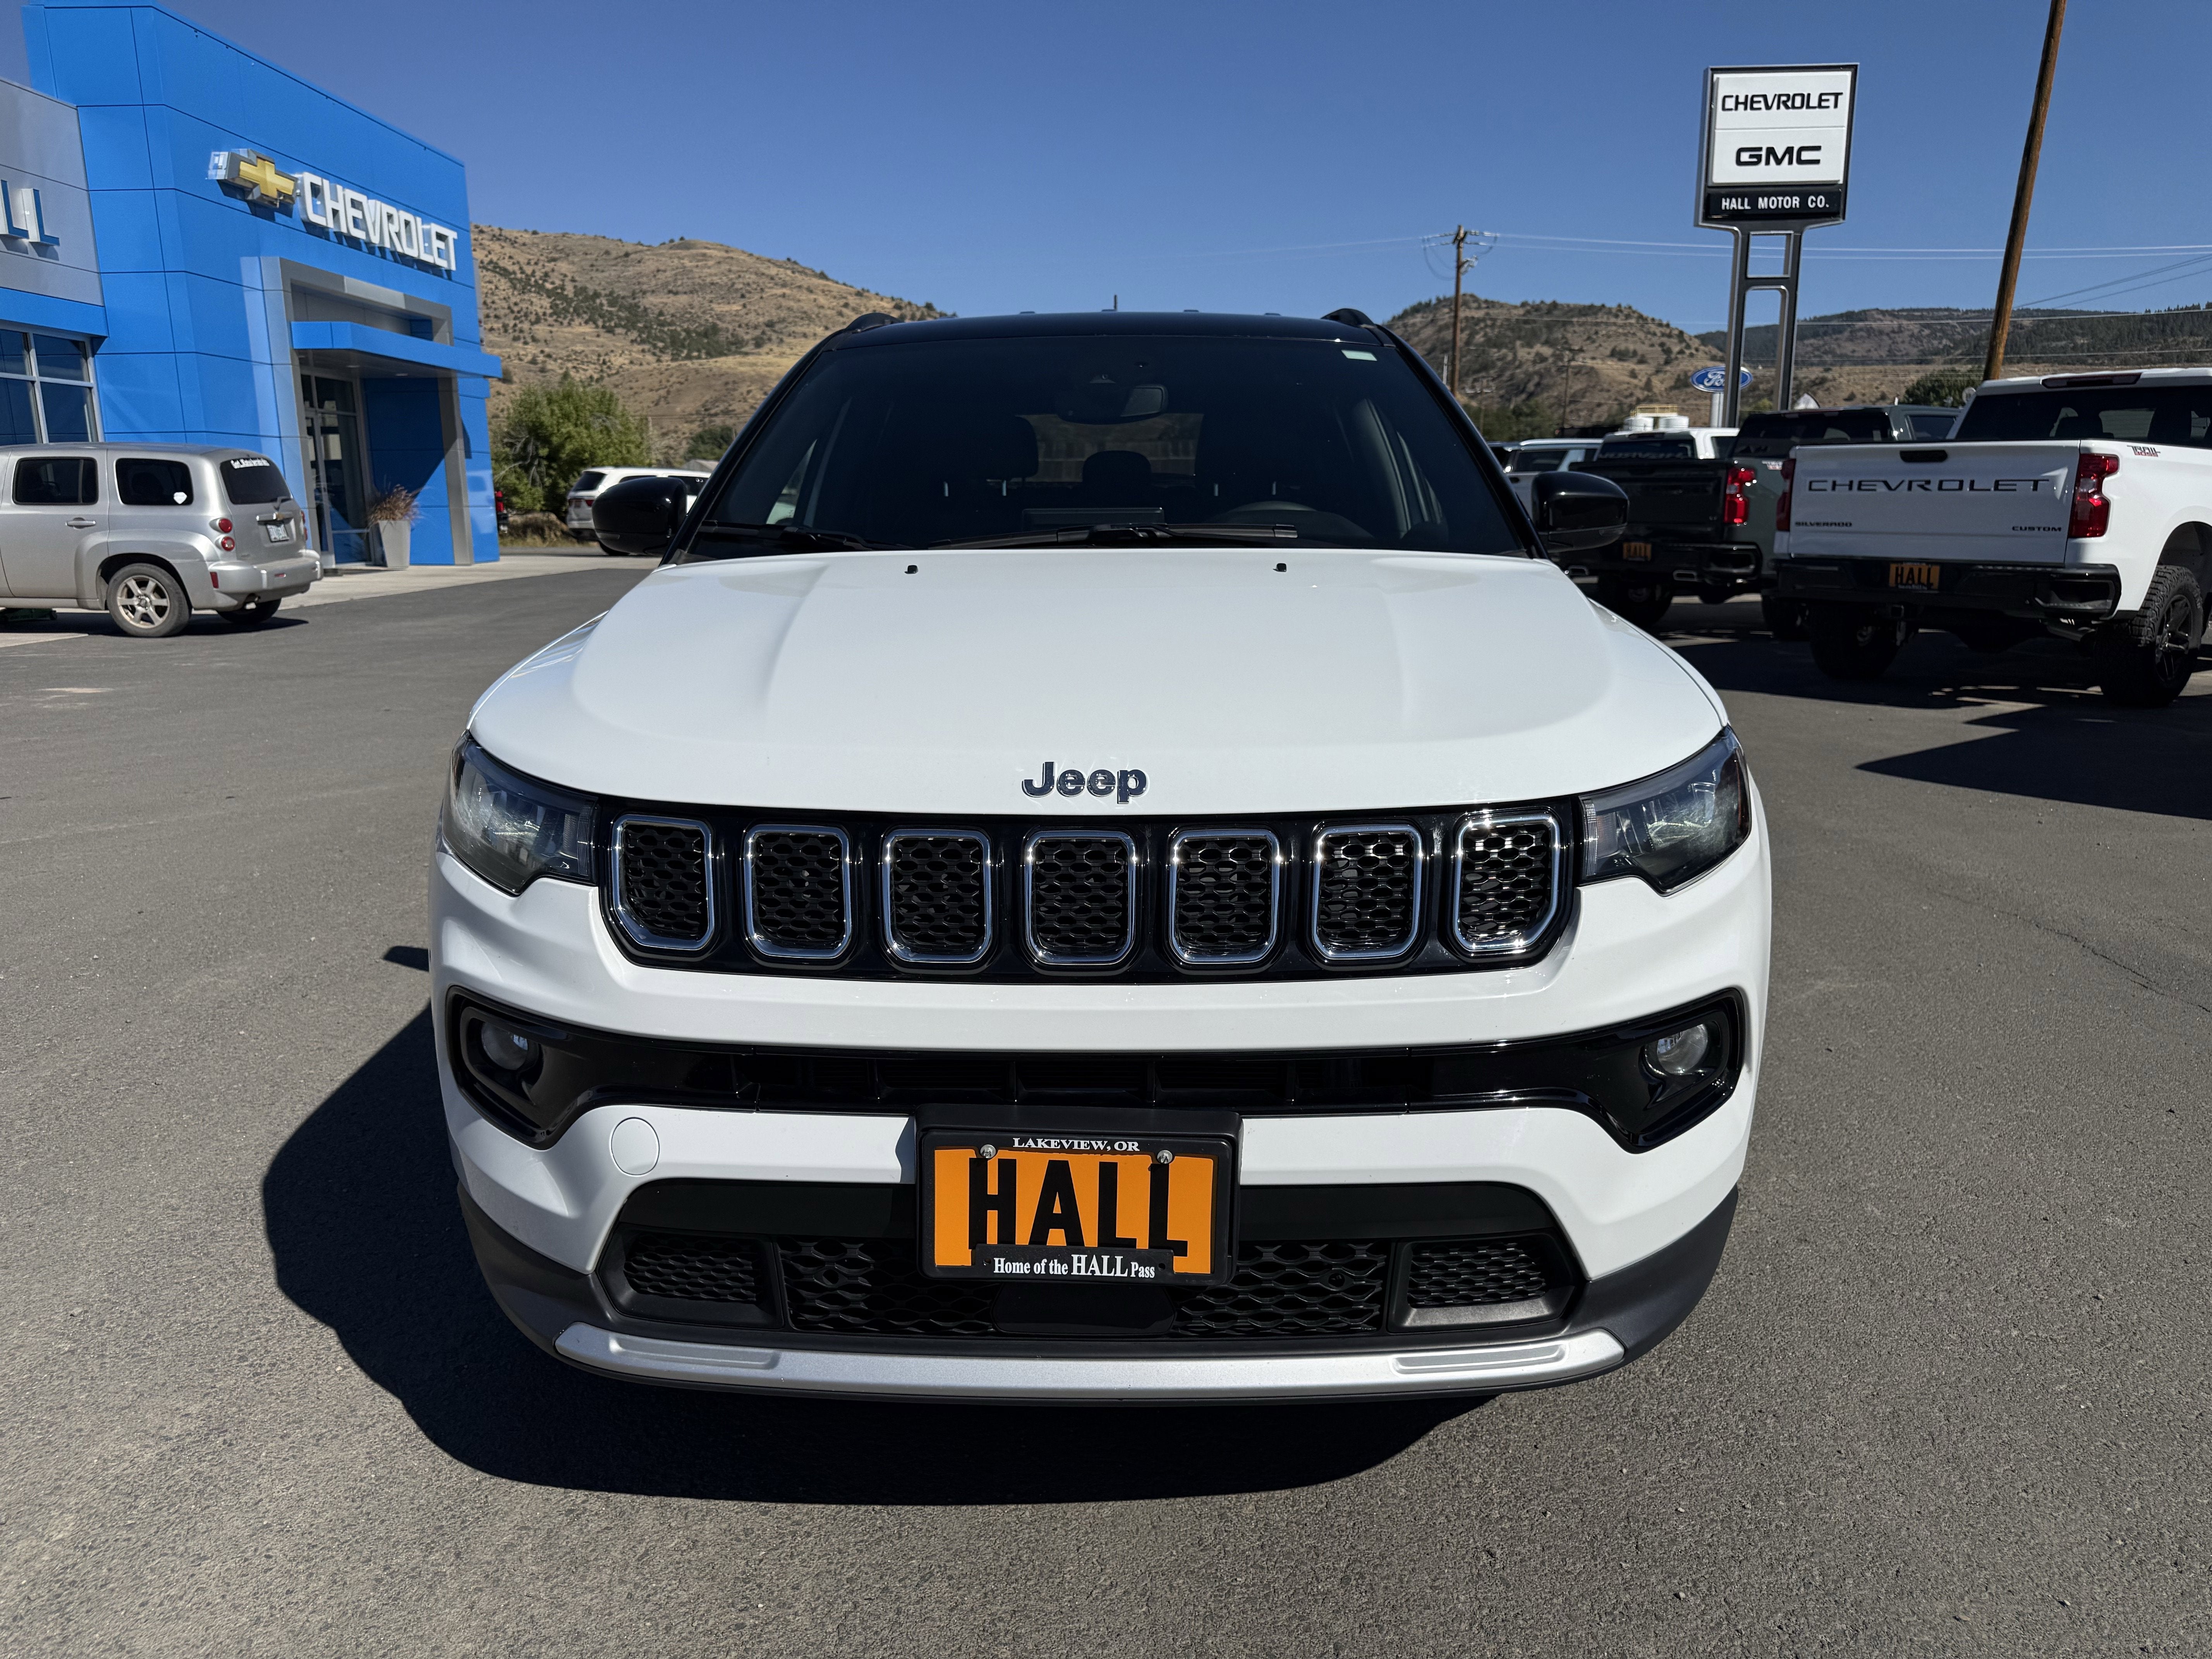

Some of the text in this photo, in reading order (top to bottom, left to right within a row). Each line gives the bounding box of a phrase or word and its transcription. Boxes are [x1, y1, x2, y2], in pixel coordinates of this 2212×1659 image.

[1722, 92, 1843, 111] CHEVROLET
[1735, 146, 1822, 167] GMC
[1722, 195, 1829, 210] HALL MOTOR CO.
[300, 171, 458, 271] CHEVROLET
[1808, 479, 2049, 492] CHEVROLET
[1895, 567, 1933, 588] HALL
[1022, 761, 1148, 804] Jeep
[1013, 1137, 1140, 1152] LAKEVIEW, OR
[969, 1157, 1188, 1257] HALL
[994, 1255, 1155, 1279] Home of the HALL Pass
